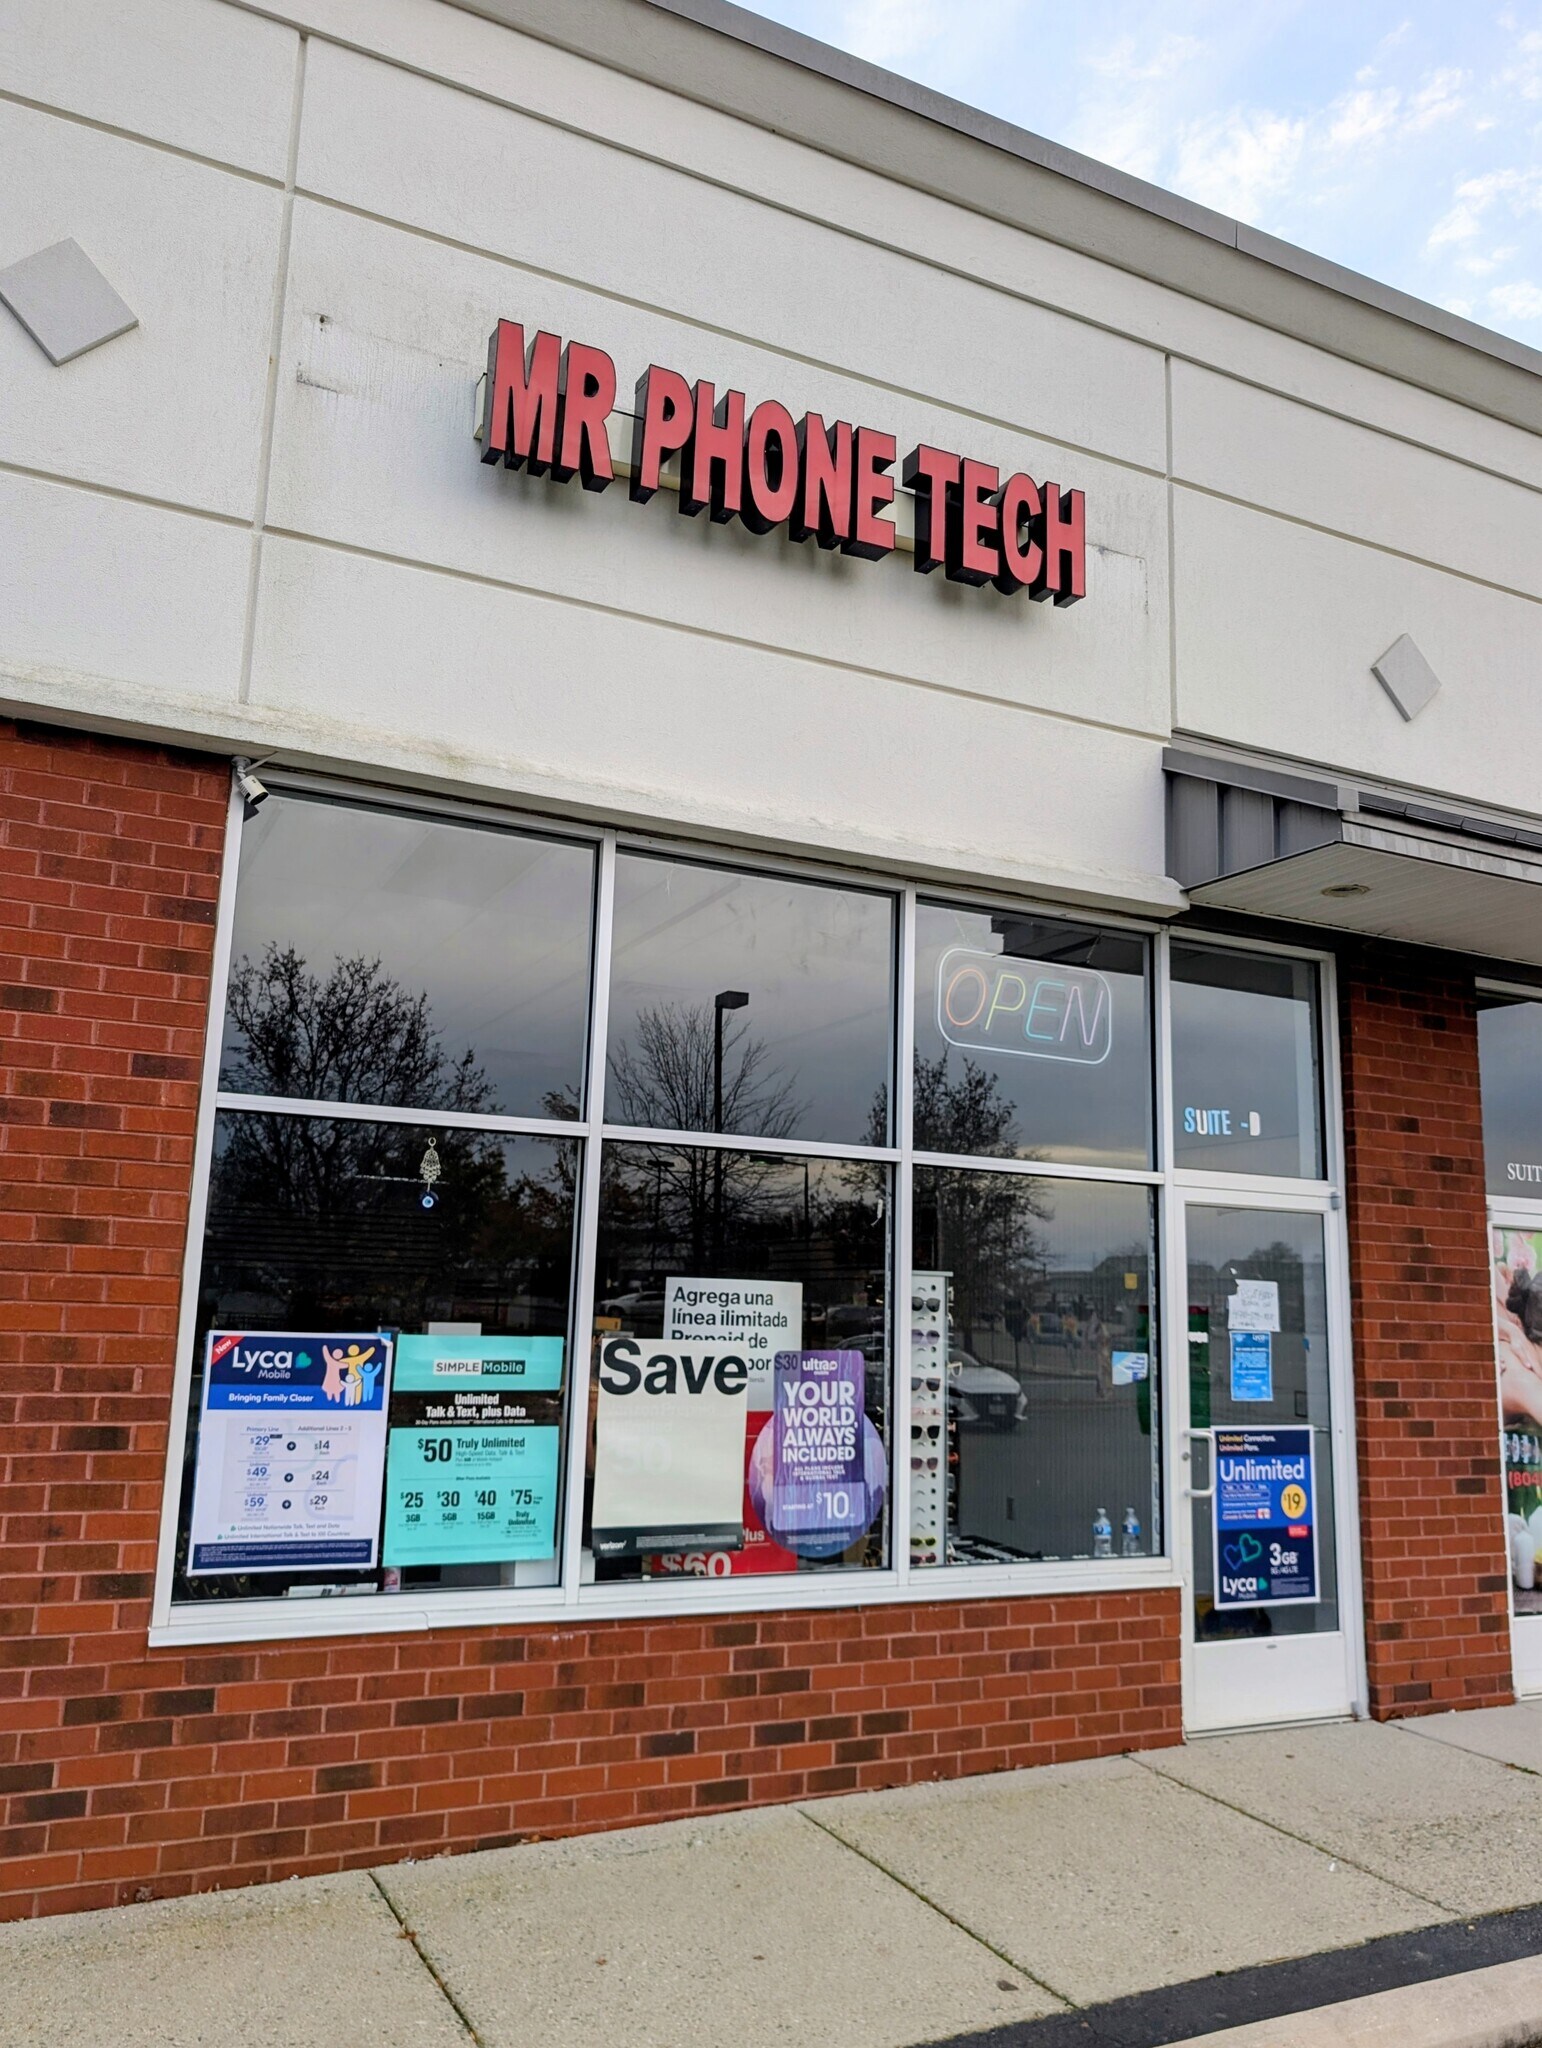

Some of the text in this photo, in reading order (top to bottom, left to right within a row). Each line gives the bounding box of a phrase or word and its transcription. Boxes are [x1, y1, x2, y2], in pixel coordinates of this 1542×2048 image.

[487, 317, 1087, 602] MR PHONE TECH
[945, 967, 1104, 1046] OPEN
[1184, 1106, 1232, 1136] SUITE
[672, 1286, 774, 1307] Agrega una
[671, 1307, 788, 1328] línea ilimitada
[215, 1339, 232, 1354] New
[748, 1333, 768, 1349] de
[232, 1346, 293, 1373] Lyca
[436, 1361, 523, 1373] SIMPLE Mobile
[600, 1338, 749, 1396] Save
[258, 1369, 291, 1379] Mobile
[229, 1393, 314, 1403] Bringing Family Closer
[454, 1393, 499, 1405] Unlimited
[783, 1381, 855, 1407] YOUR
[425, 1405, 526, 1419] Talk & Text, plus Data
[783, 1406, 858, 1428] WORLD,
[250, 1436, 270, 1446] $29
[456, 1437, 525, 1450] Truly Unlimited
[783, 1426, 855, 1447] ALWAYS
[314, 1440, 330, 1450] $14
[417, 1438, 453, 1463] $50
[783, 1446, 855, 1463] INCLUDED
[247, 1467, 268, 1477] $49
[312, 1471, 329, 1481] $24
[1219, 1457, 1305, 1482] Unlimited
[244, 1497, 264, 1507] $59
[309, 1495, 328, 1505] $29
[400, 1492, 424, 1508] $25
[436, 1490, 460, 1507] $30
[474, 1490, 497, 1506] $40
[510, 1489, 533, 1505] $75
[816, 1491, 850, 1519] $10
[405, 1514, 421, 1522] 3GB
[442, 1513, 457, 1521] 5GB
[477, 1511, 495, 1520] 15GB
[508, 1518, 536, 1526] Unlimited
[515, 1511, 530, 1519] Truly
[1269, 1542, 1298, 1566] 3GB
[1222, 1575, 1258, 1596] Lyca
